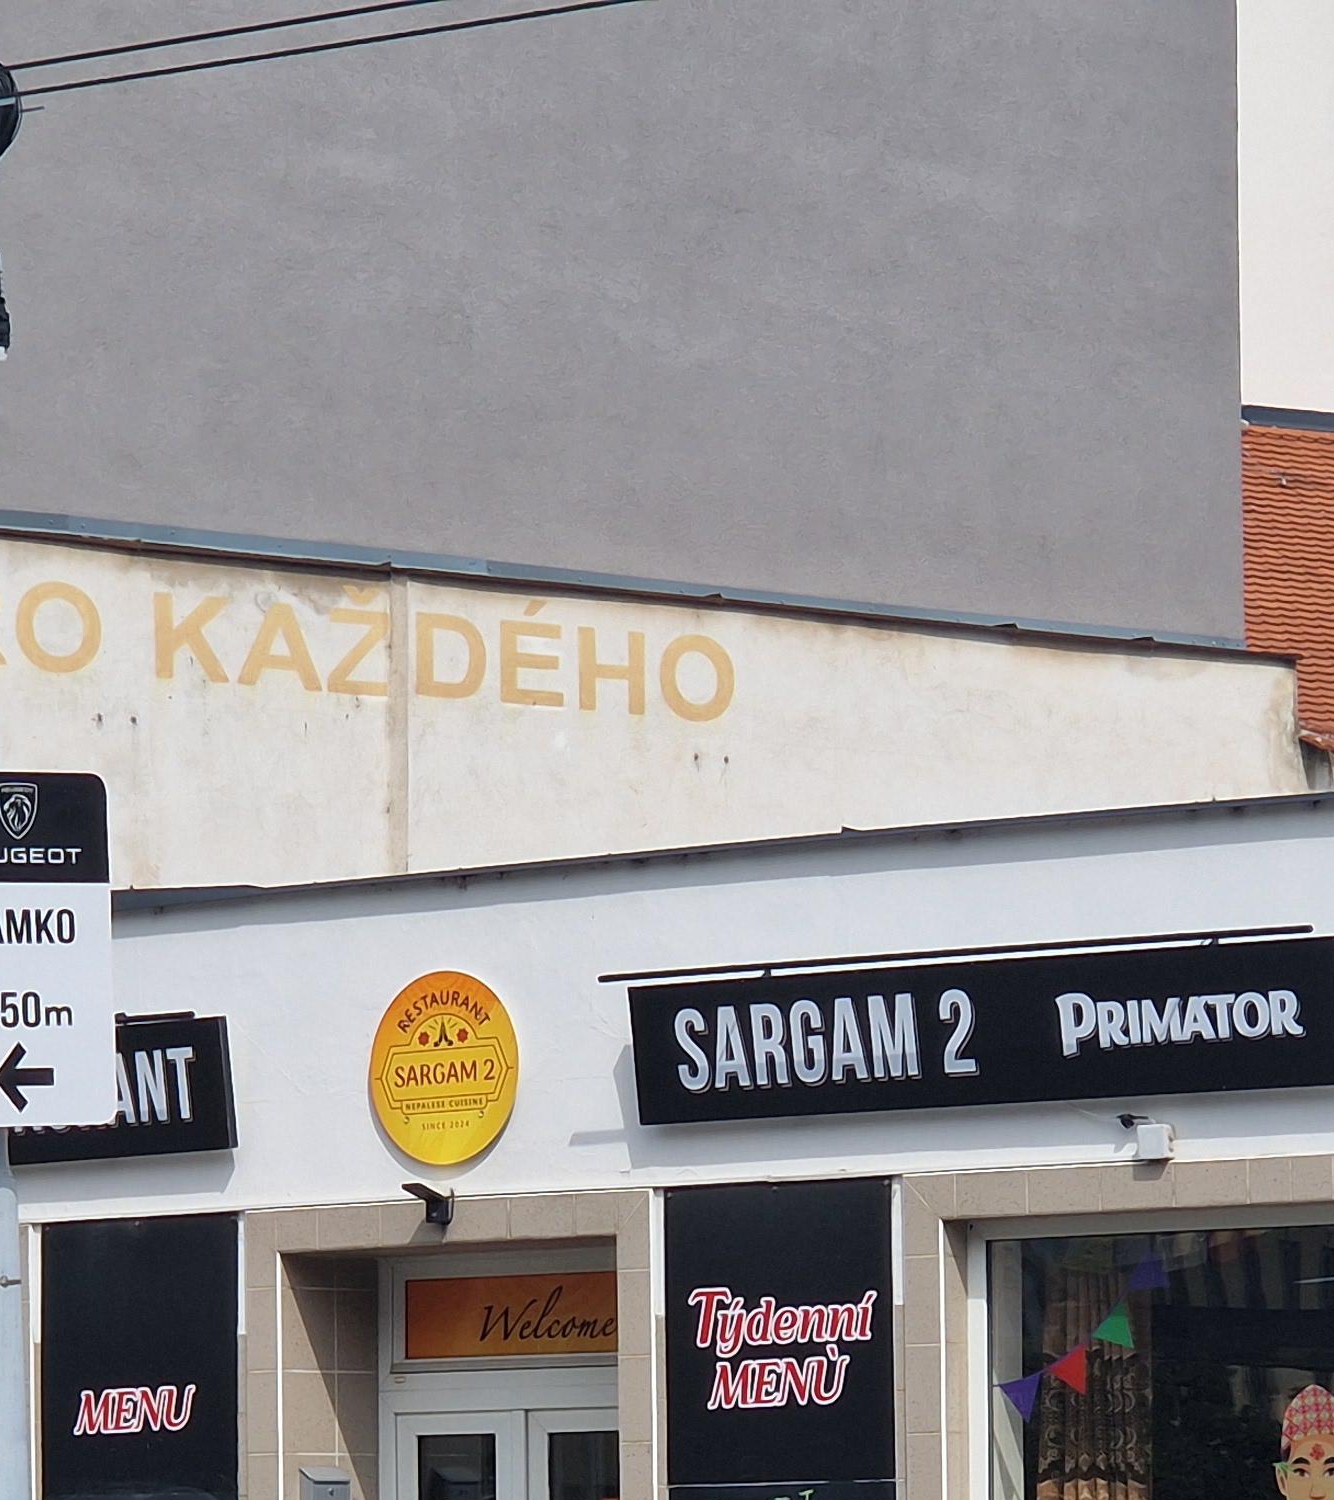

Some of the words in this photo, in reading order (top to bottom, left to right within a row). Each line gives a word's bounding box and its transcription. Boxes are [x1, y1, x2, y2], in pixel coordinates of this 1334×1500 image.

[153, 584, 735, 722] KAŽDÉHO
[397, 990, 491, 1034] RESTAURANT
[673, 993, 922, 1094] SARGAM
[938, 988, 980, 1077] 2
[1055, 990, 1307, 1059] PRIMATOR
[394, 1060, 478, 1088] SARGAM
[483, 1058, 496, 1081] 2
[405, 1101, 445, 1111] NEPALESE
[448, 1098, 484, 1108] CUISINE
[422, 1123, 448, 1131] SINCE
[479, 1285, 618, 1342] Welcome
[689, 1287, 878, 1358] Týdenní
[74, 1384, 196, 1436] MENU
